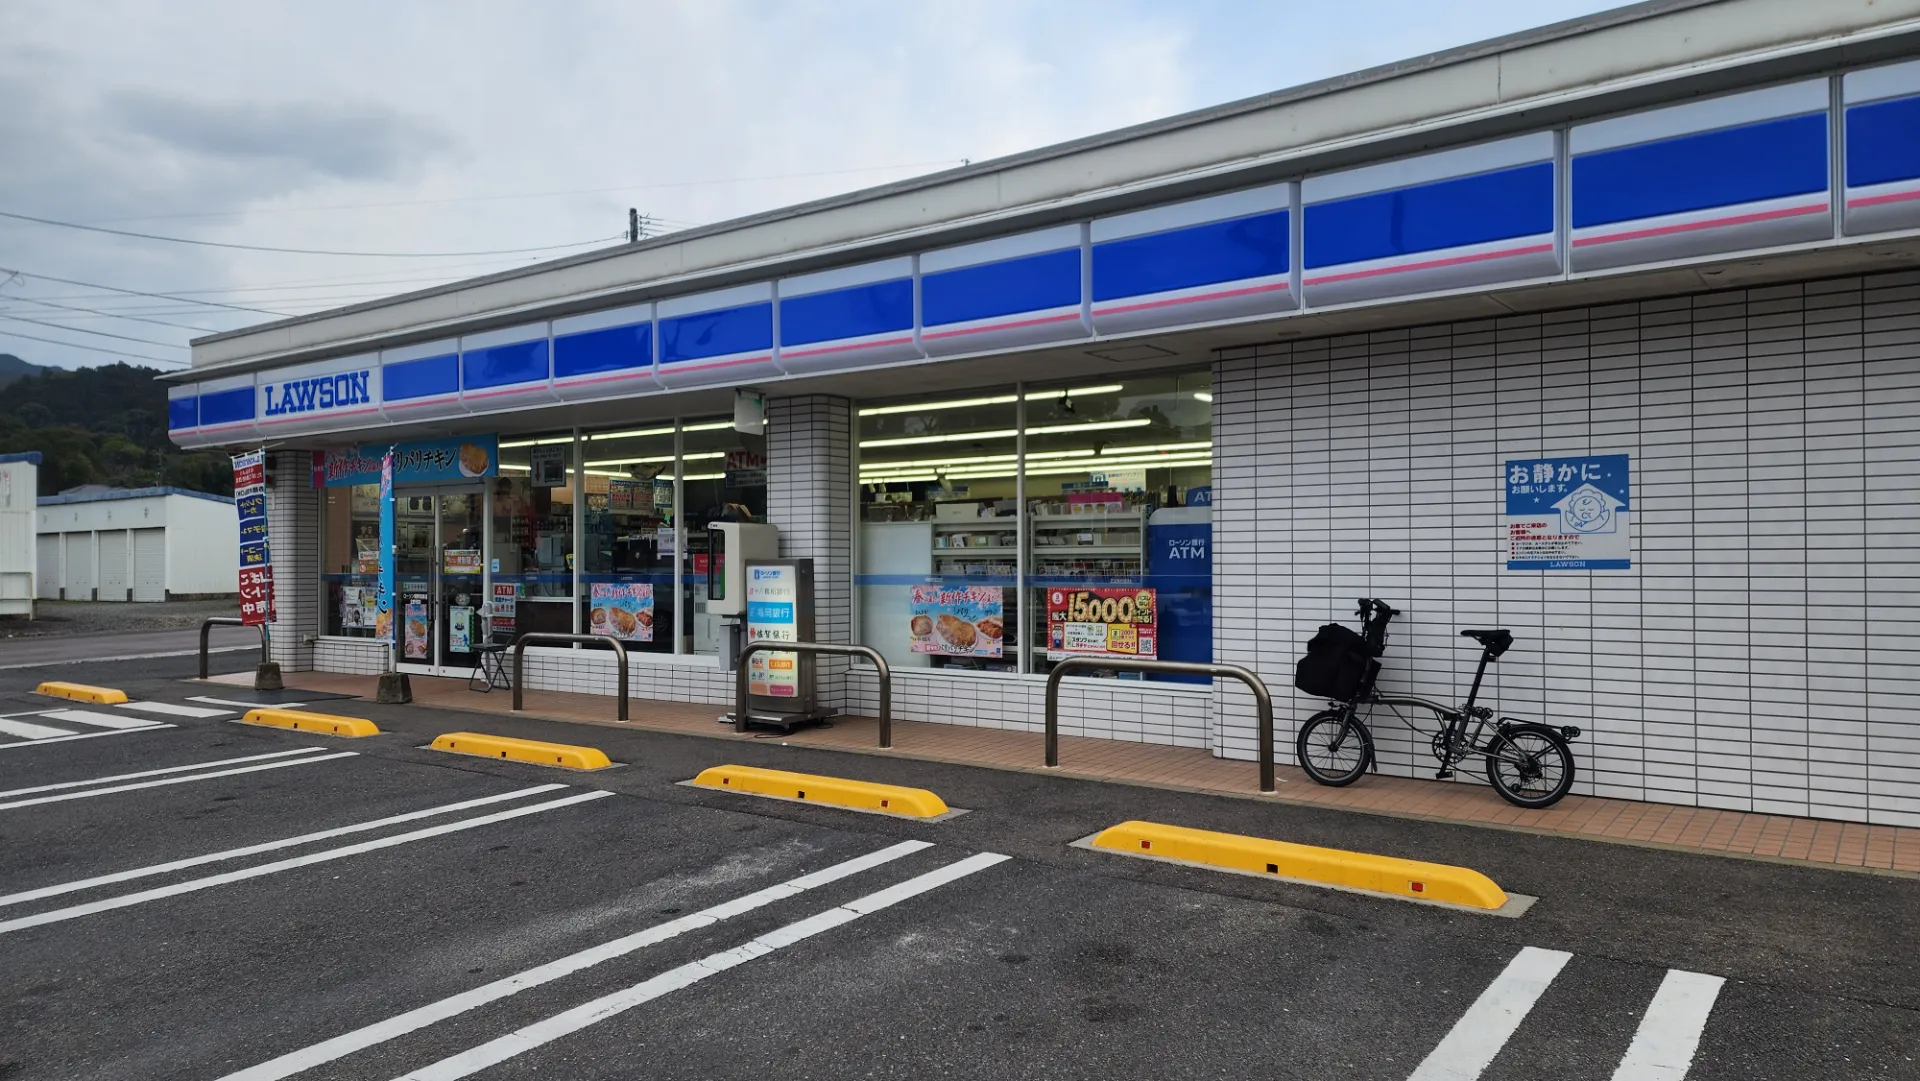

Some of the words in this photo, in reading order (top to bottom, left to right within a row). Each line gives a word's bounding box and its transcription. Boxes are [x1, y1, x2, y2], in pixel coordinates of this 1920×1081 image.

[265, 370, 370, 416] LAWSON
[1509, 463, 1602, 485] お静かに
[1511, 483, 1568, 495] お願いします。
[1168, 539, 1205, 547] ローソン銀行
[1168, 547, 1205, 560] ATM
[1550, 561, 1586, 569] LAWSON
[496, 586, 512, 595] ATM
[1067, 590, 1135, 623] 15,000
